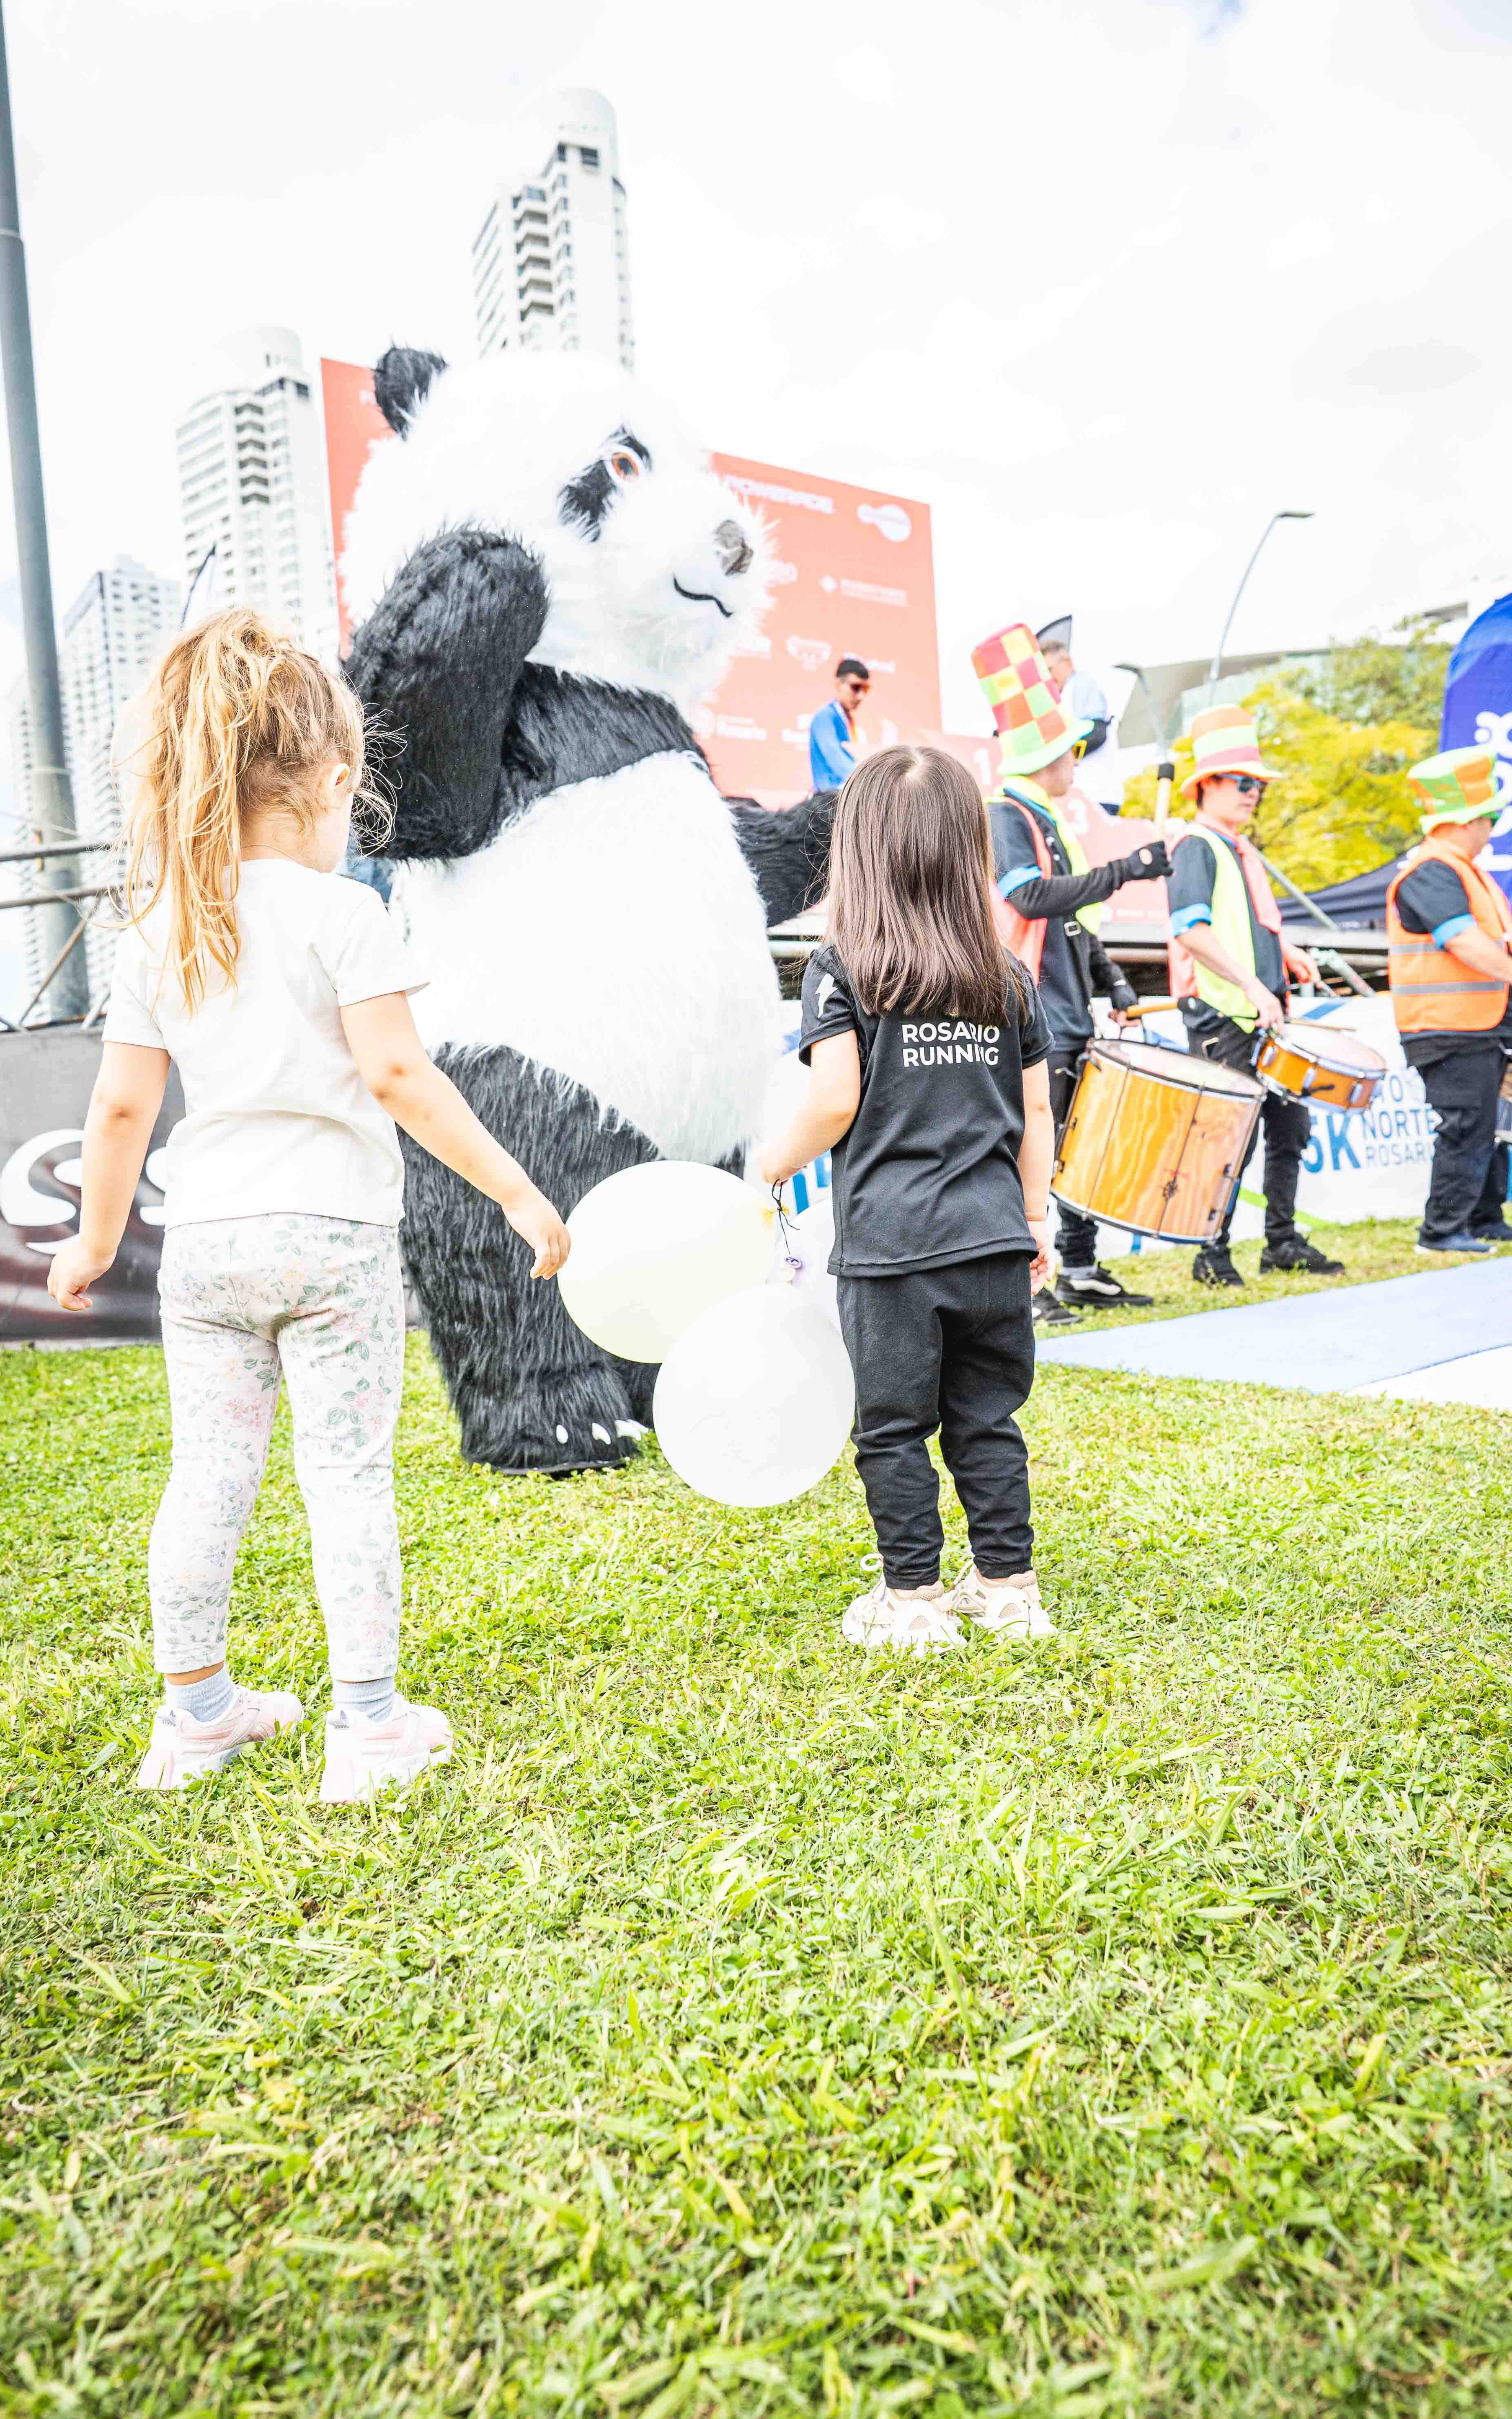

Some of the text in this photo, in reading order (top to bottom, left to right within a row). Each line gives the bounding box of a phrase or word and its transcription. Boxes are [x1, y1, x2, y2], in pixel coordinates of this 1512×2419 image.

[901, 1021, 1000, 1043] ROSARIO
[1360, 1107, 1439, 1139] NORTE
[1301, 1114, 1361, 1173] 5K
